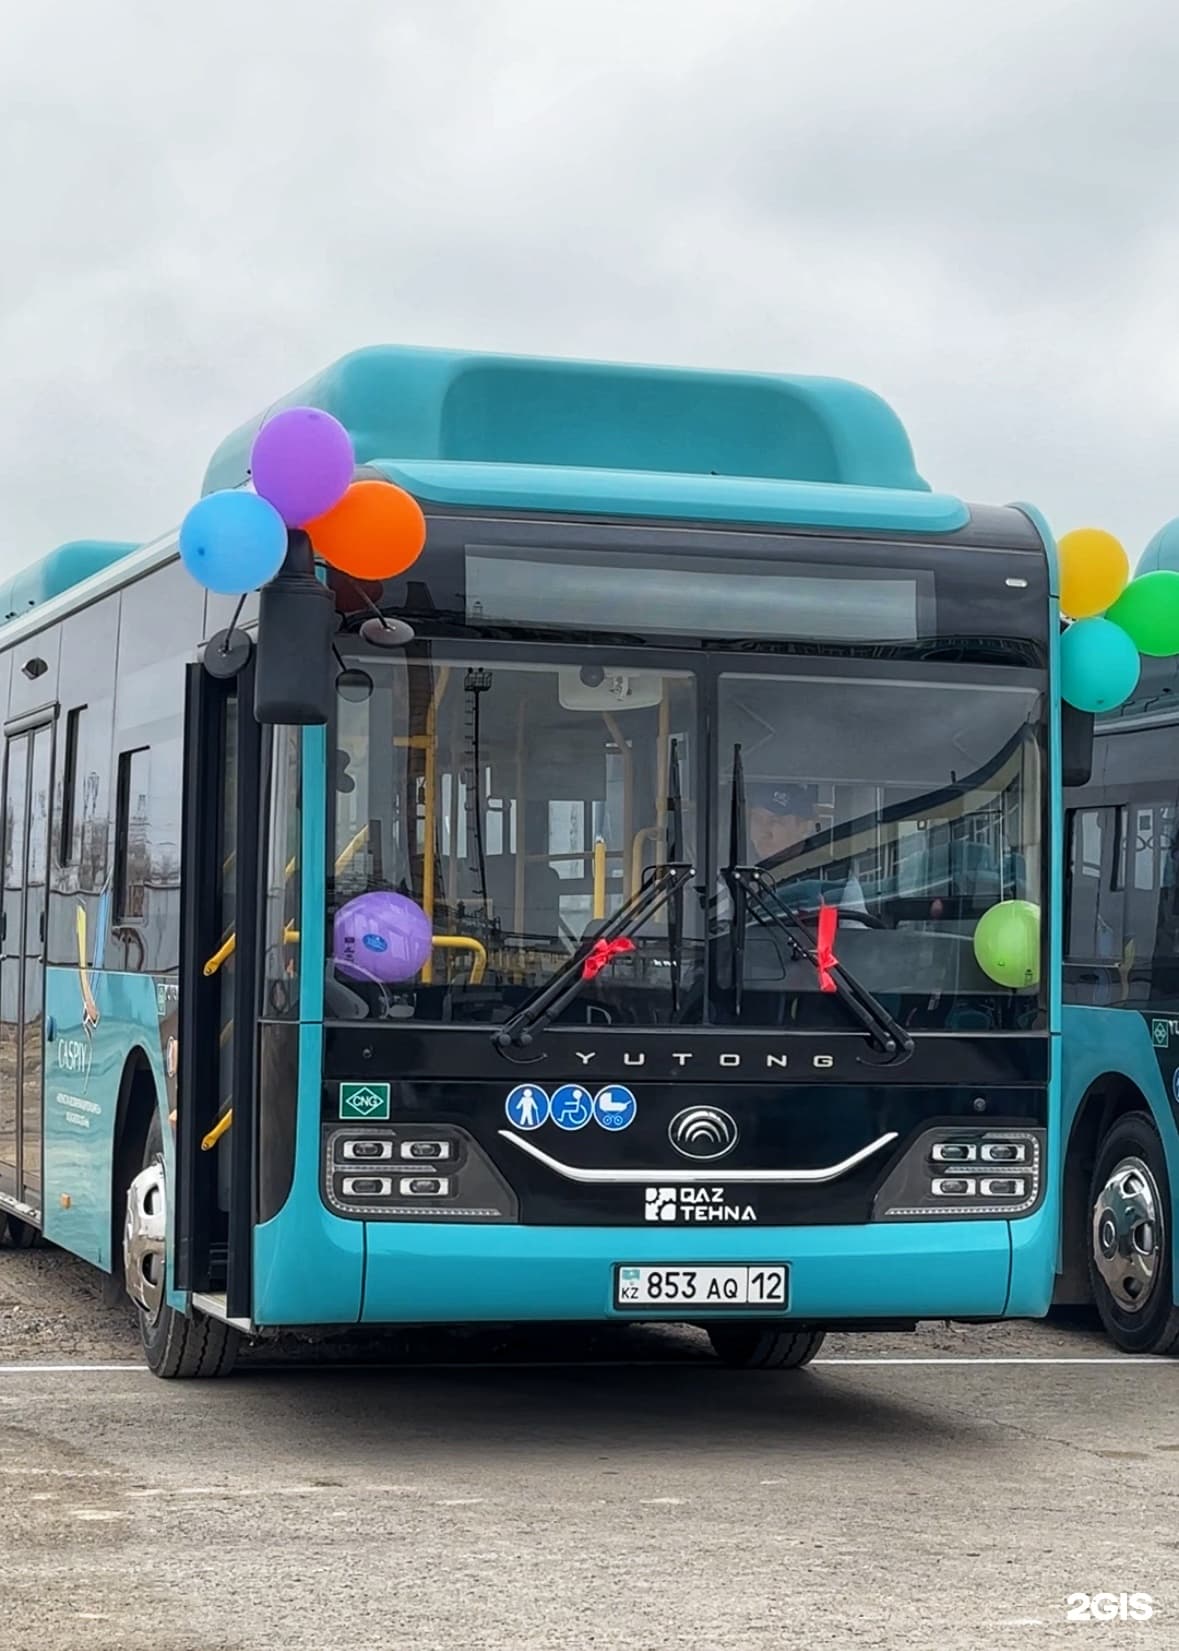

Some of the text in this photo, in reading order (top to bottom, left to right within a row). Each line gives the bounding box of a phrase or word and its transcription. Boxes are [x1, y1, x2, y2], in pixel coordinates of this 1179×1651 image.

[575, 1052, 834, 1068] YUTONG
[353, 1095, 379, 1107] CNG
[680, 1187, 724, 1204] QAZ
[679, 1205, 757, 1221] TEHNA
[621, 1271, 782, 1300] KZ 853 AQ 12
